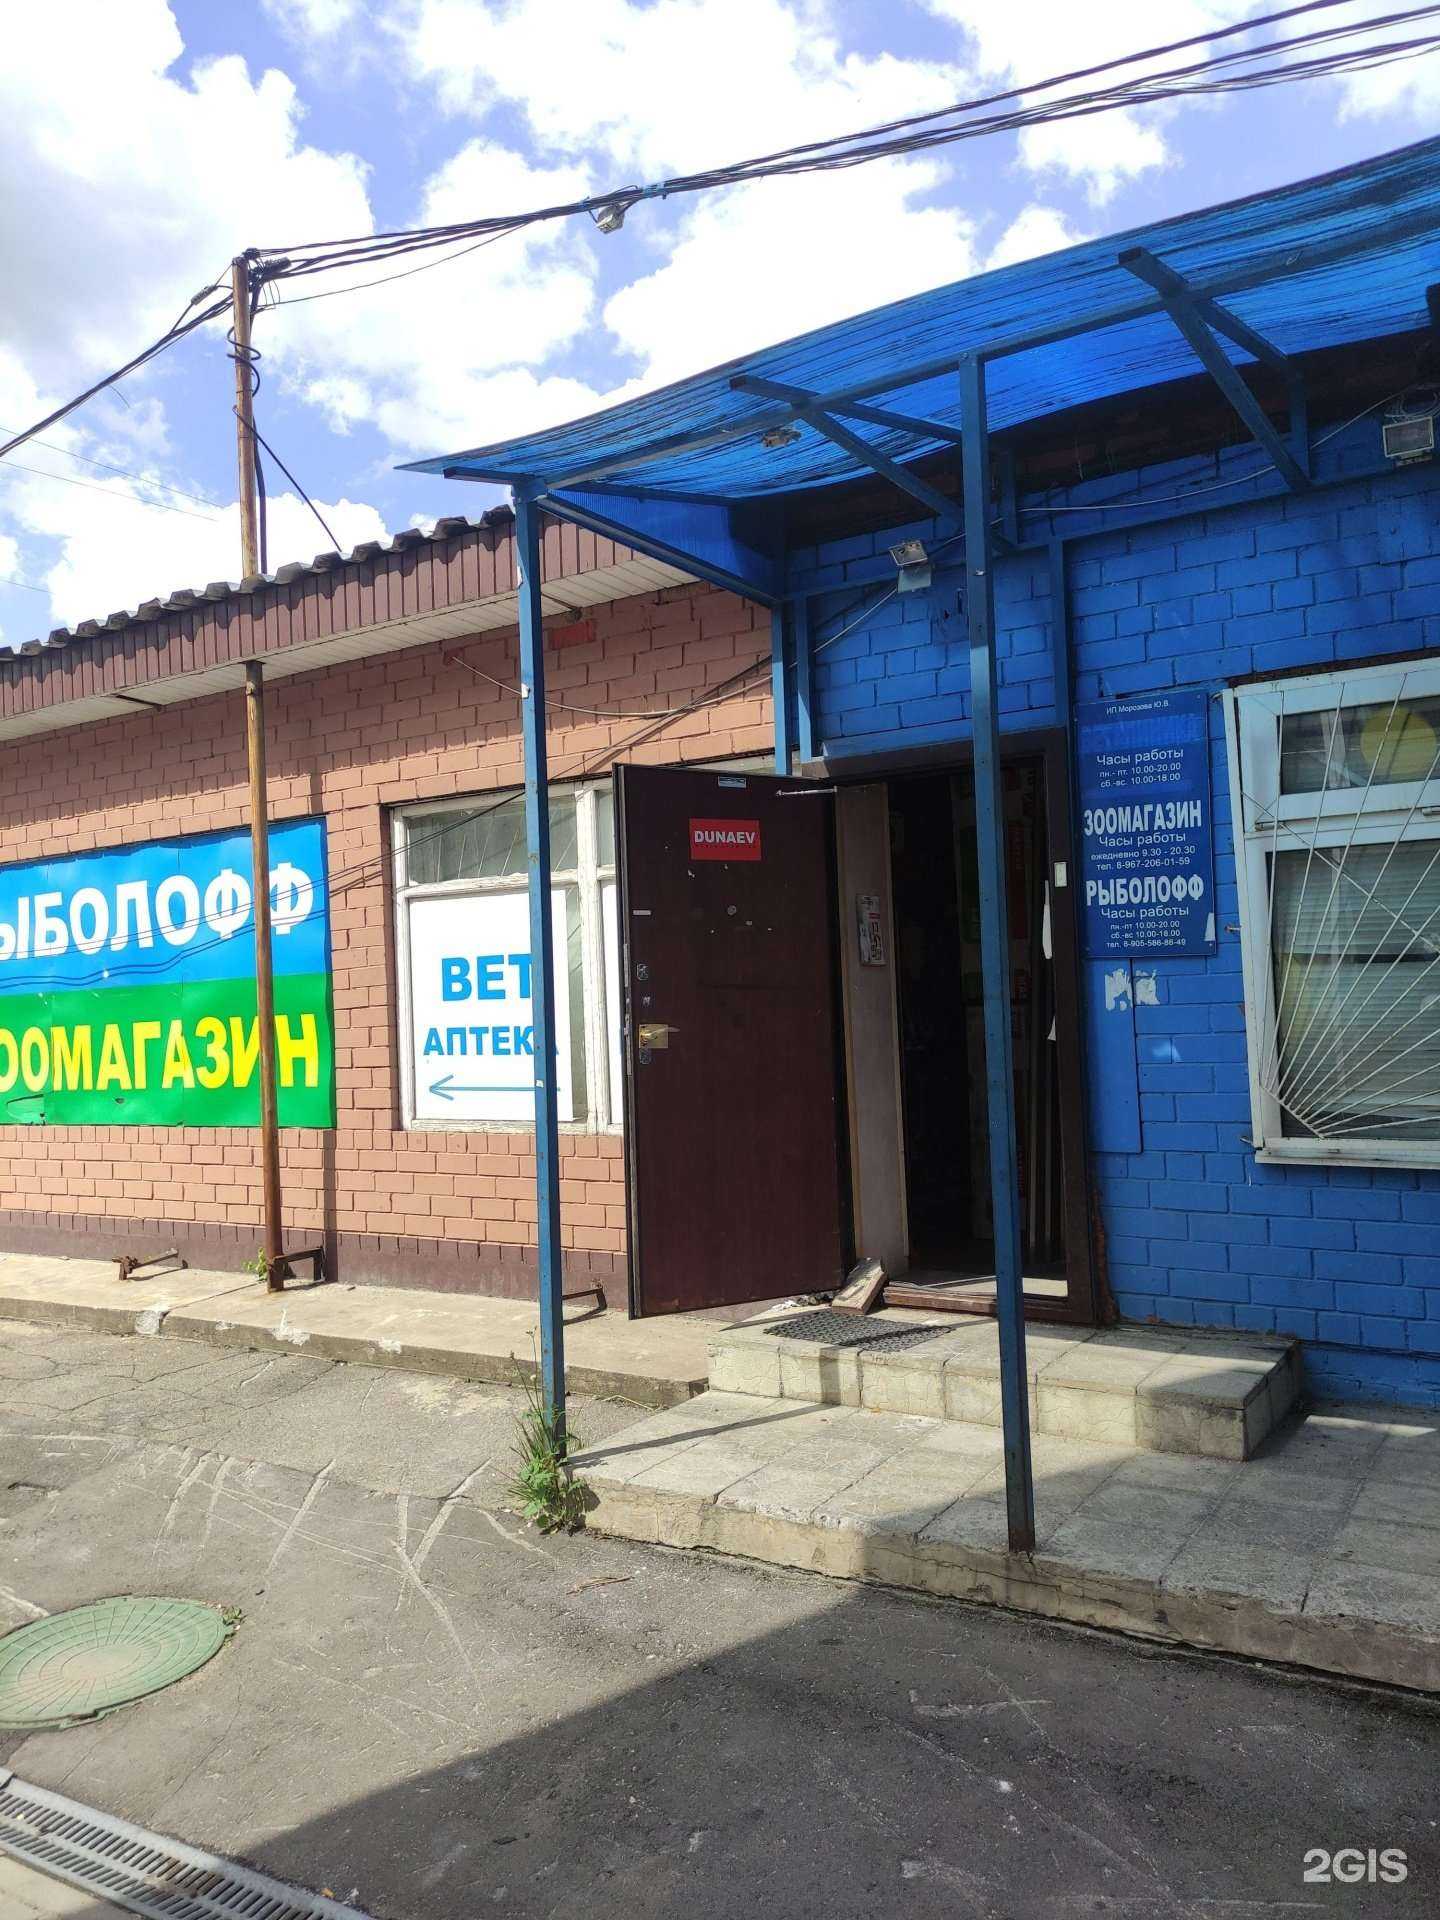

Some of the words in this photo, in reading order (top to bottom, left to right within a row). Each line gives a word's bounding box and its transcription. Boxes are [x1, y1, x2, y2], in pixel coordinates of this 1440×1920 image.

[1106, 706, 1117, 715] ИП
[1096, 754, 1131, 766] Часы
[1135, 748, 1184, 765] работы
[1131, 762, 1181, 775] 10.00-20.00
[1131, 772, 1181, 785] 10.00-18.00
[1084, 799, 1202, 836] ЗООМАГАЗИН
[694, 830, 756, 844] DUNAEV
[1099, 836, 1133, 847] Часы
[1137, 832, 1186, 847] работы
[1090, 851, 1140, 860] ежедневно
[1142, 848, 1161, 857] 9.30
[1169, 845, 1196, 855] 20.30
[1096, 863, 1114, 871] тел.
[1085, 873, 1204, 907] РЫБОЛОФФ
[0, 862, 313, 960] ЫБОЛОФФ
[1101, 907, 1136, 919] Часы
[1139, 905, 1189, 920] работы
[1135, 920, 1180, 929] 10.00-20.00
[1136, 929, 1181, 938] 10.00-18.00
[441, 953, 532, 1001] ВЕТ
[423, 1025, 559, 1056] АПТЕК
